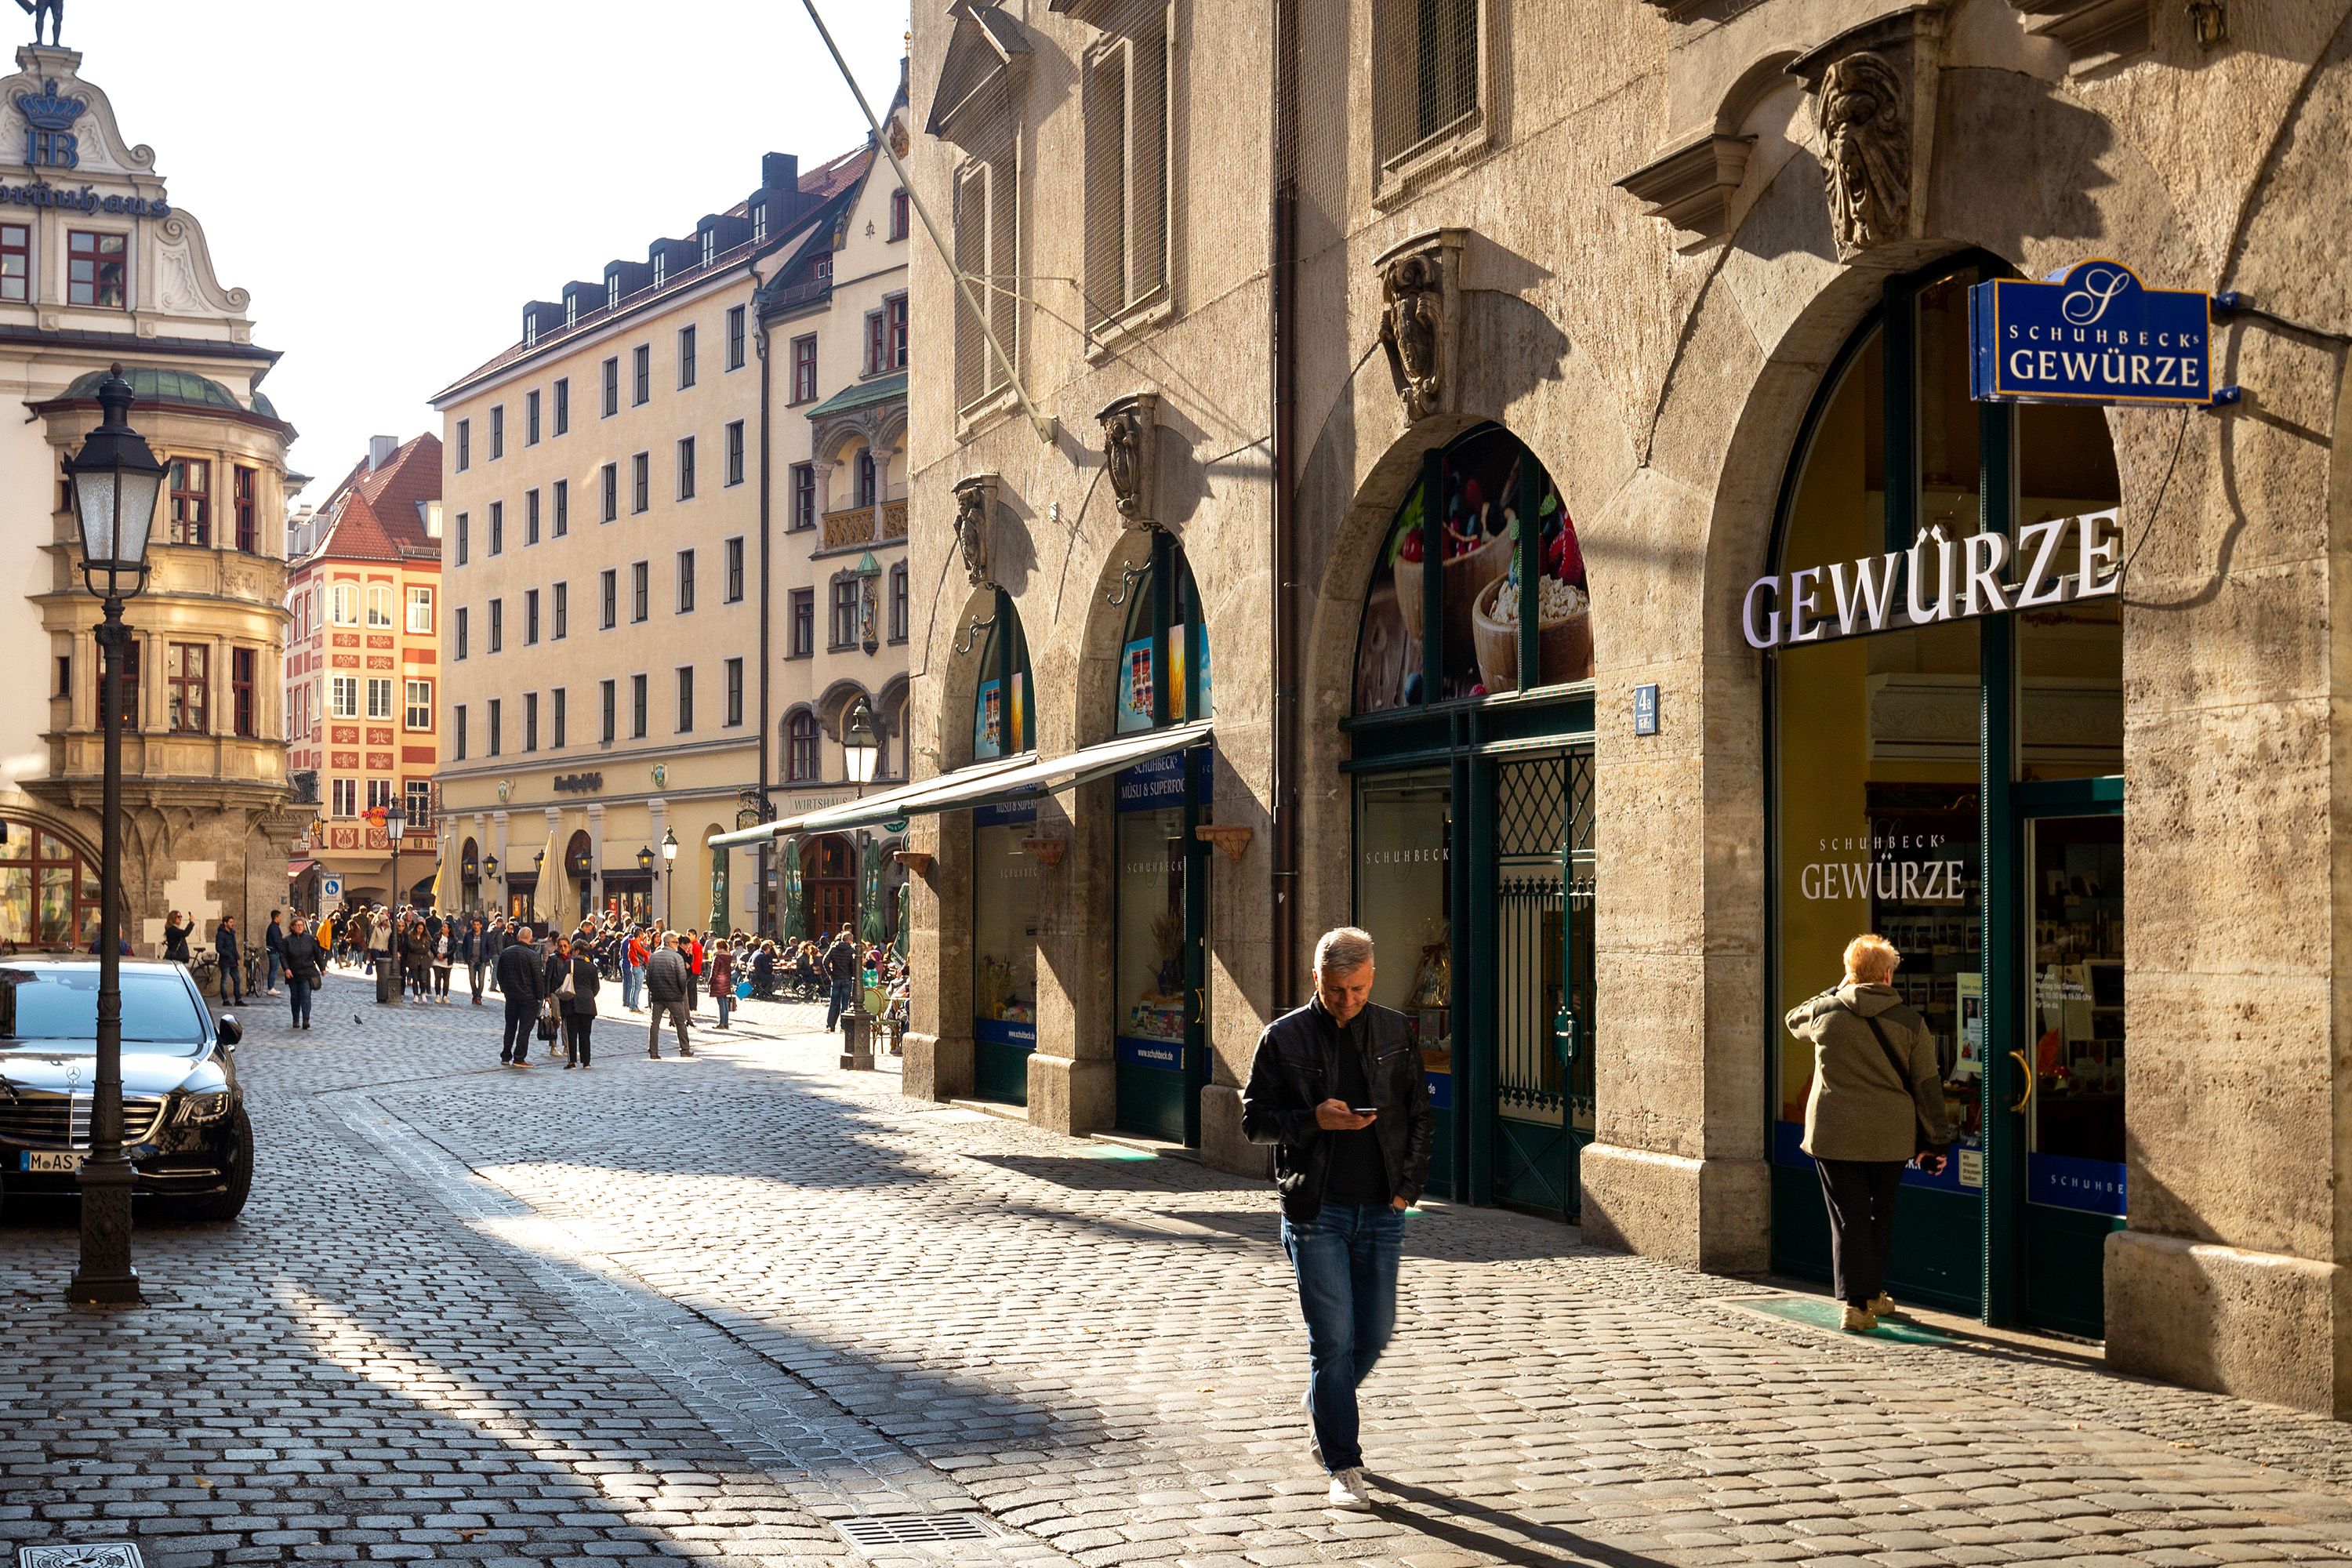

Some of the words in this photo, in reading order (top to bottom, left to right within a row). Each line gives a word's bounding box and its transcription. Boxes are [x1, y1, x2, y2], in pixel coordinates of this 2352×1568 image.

[24, 127, 78, 169] HB
[2009, 347, 2200, 387] GEWÜRZE
[1742, 507, 2122, 649] GEWÜRZE
[1639, 689, 1652, 711] 4a
[1143, 785, 1149, 797] &
[1367, 848, 1449, 864] SCHUHBECK
[1801, 852, 1965, 900] GEWÜRZE
